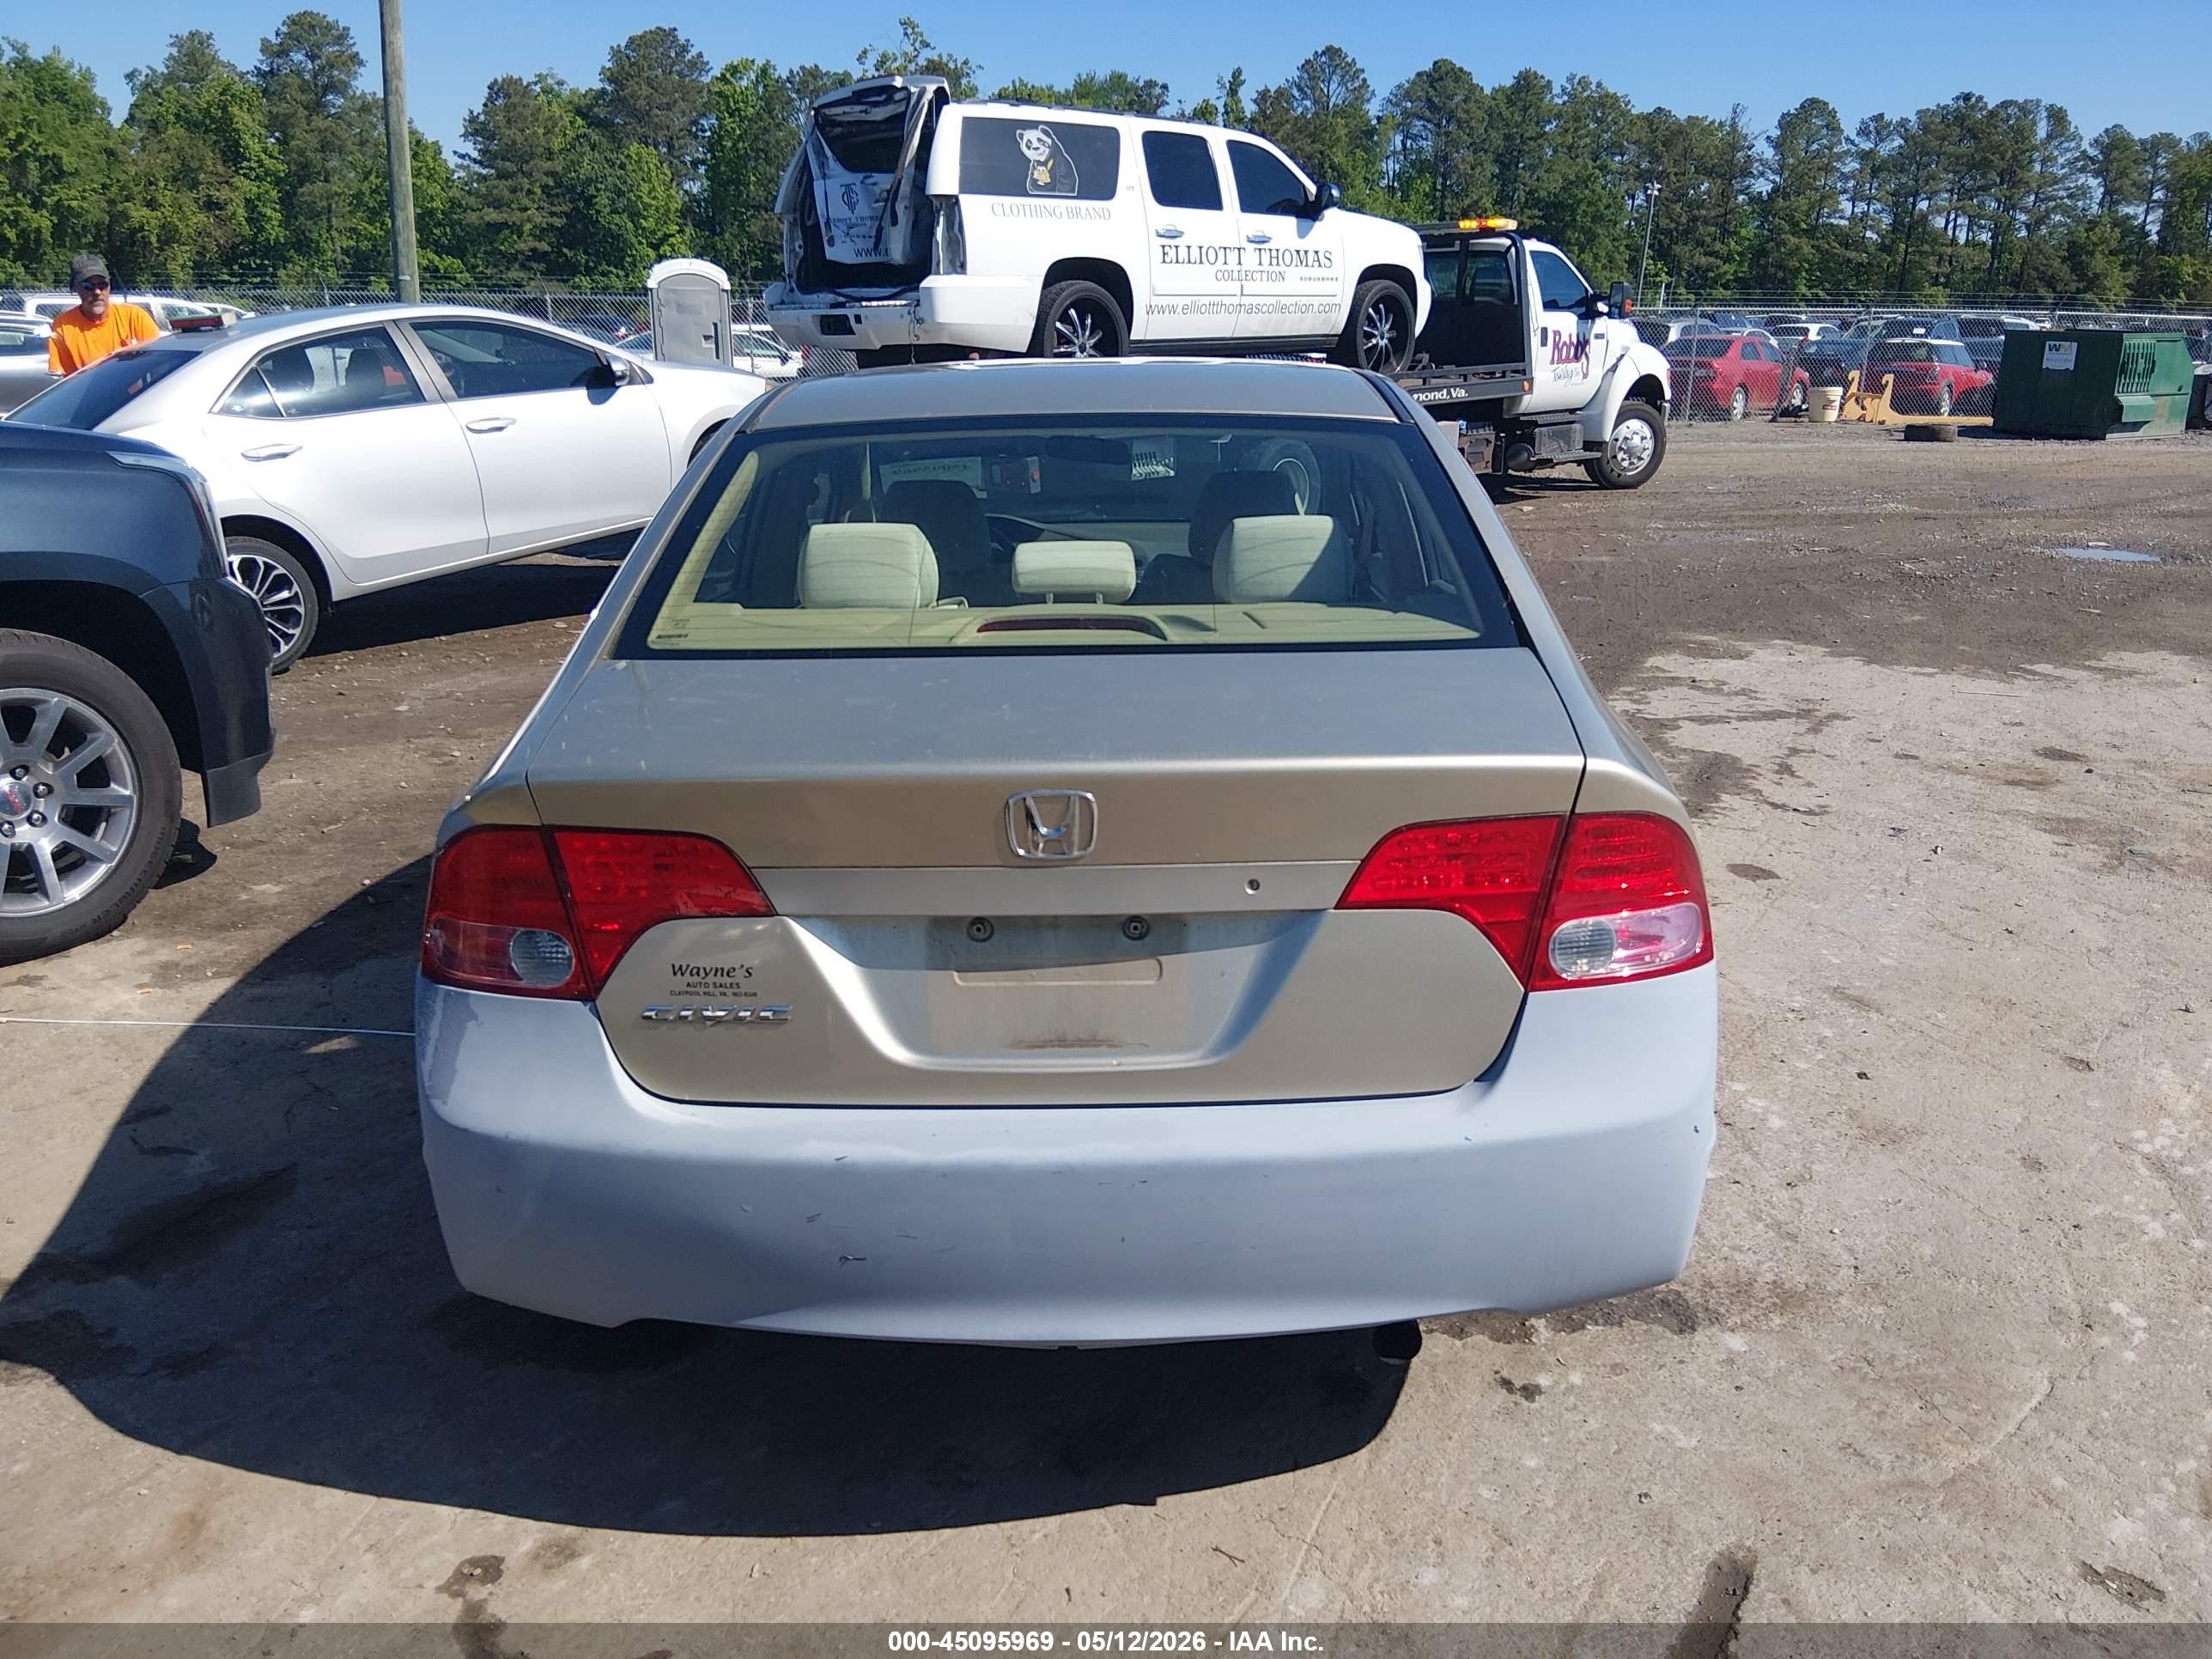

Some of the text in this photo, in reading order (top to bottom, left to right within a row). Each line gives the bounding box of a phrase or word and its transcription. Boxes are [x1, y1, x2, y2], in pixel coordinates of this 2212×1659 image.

[991, 201, 1111, 221] CLOTHING BRAND
[1160, 244, 1333, 269] ELLIOTT THOMAS
[1215, 269, 1286, 283] COLLECTION
[1146, 299, 1341, 317] www.elliottthomascollection.com
[1450, 387, 1468, 398] Va.
[671, 963, 754, 980] Wayne's
[713, 981, 741, 990] SALES
[641, 1004, 793, 1025] CIVIC
